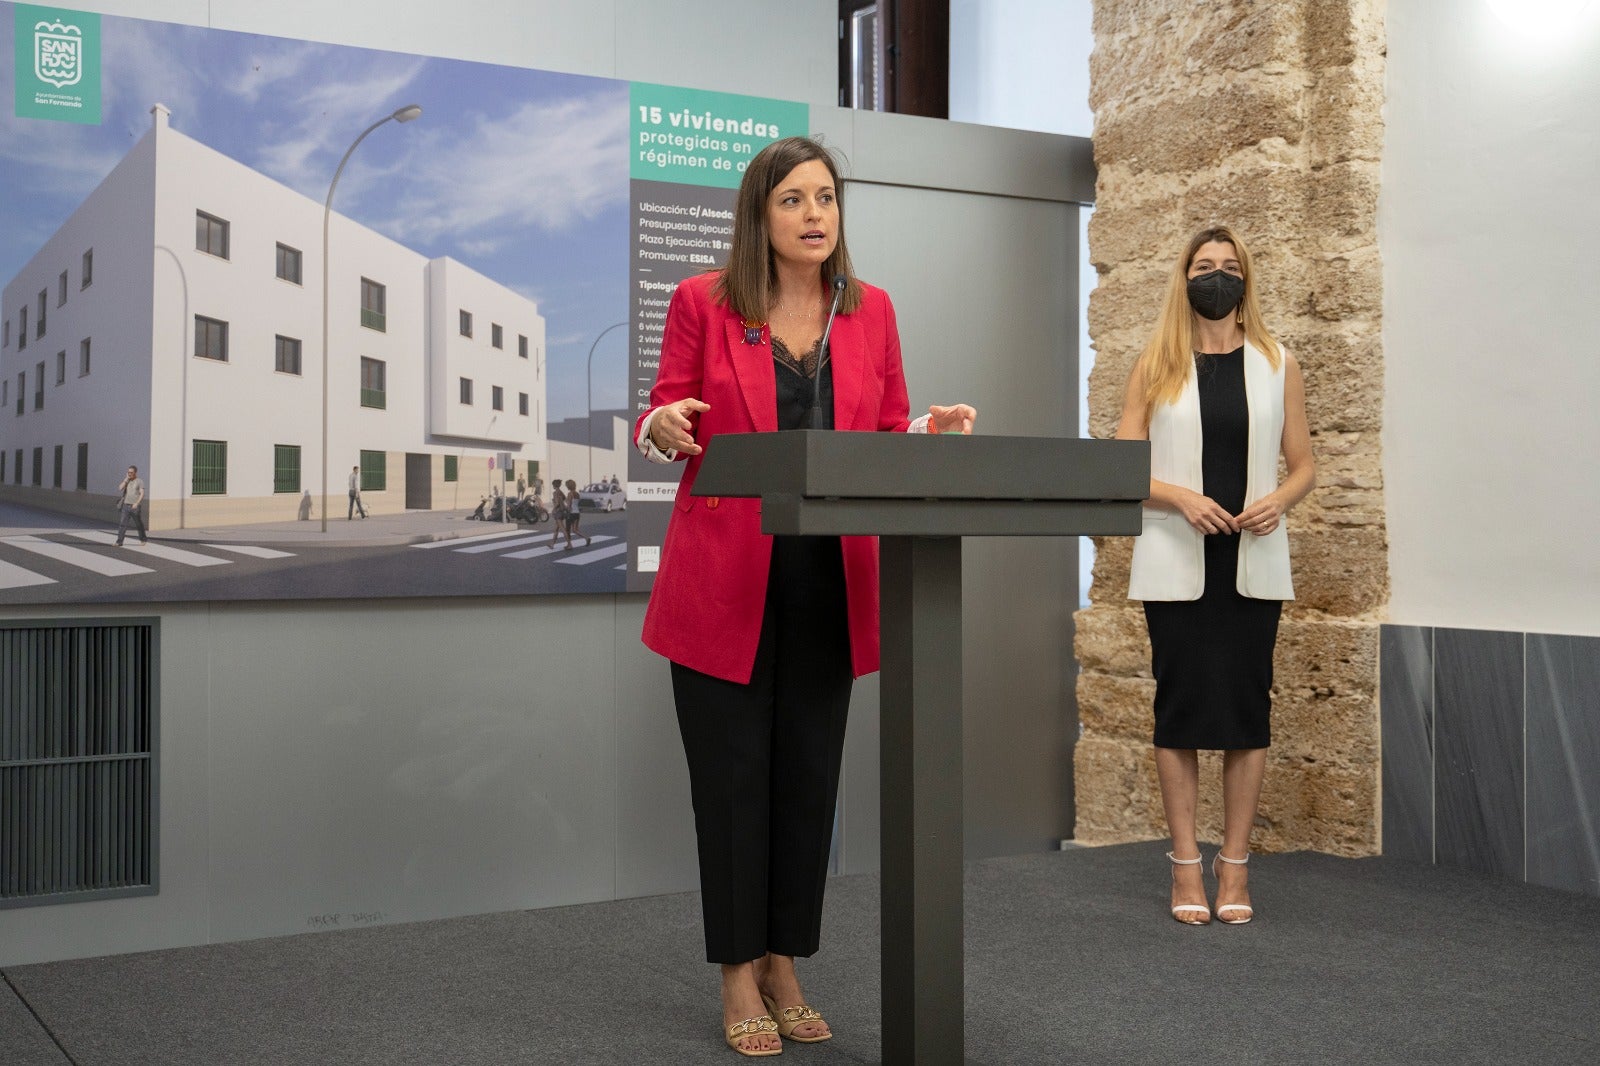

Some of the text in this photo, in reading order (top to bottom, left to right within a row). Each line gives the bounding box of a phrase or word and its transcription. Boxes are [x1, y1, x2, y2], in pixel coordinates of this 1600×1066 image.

[41, 39, 76, 55] SAN
[34, 97, 82, 108] San Fernando
[36, 93, 74, 101] Ayuntamiento
[639, 105, 780, 139] 15 viviendas
[639, 131, 751, 154] protegidas en
[639, 149, 707, 168] régimen
[712, 156, 732, 171] de
[639, 202, 689, 215] Ubicación:
[639, 217, 697, 232] Presupuesto
[639, 233, 664, 245] Plazo
[665, 236, 711, 248] Ejecución:
[711, 240, 722, 250] 18
[639, 249, 716, 264] Promueve: ESISA
[643, 298, 671, 308] viviend
[638, 310, 668, 320] 4 vivien
[638, 334, 644, 343] 2
[637, 487, 677, 495] San Fern
